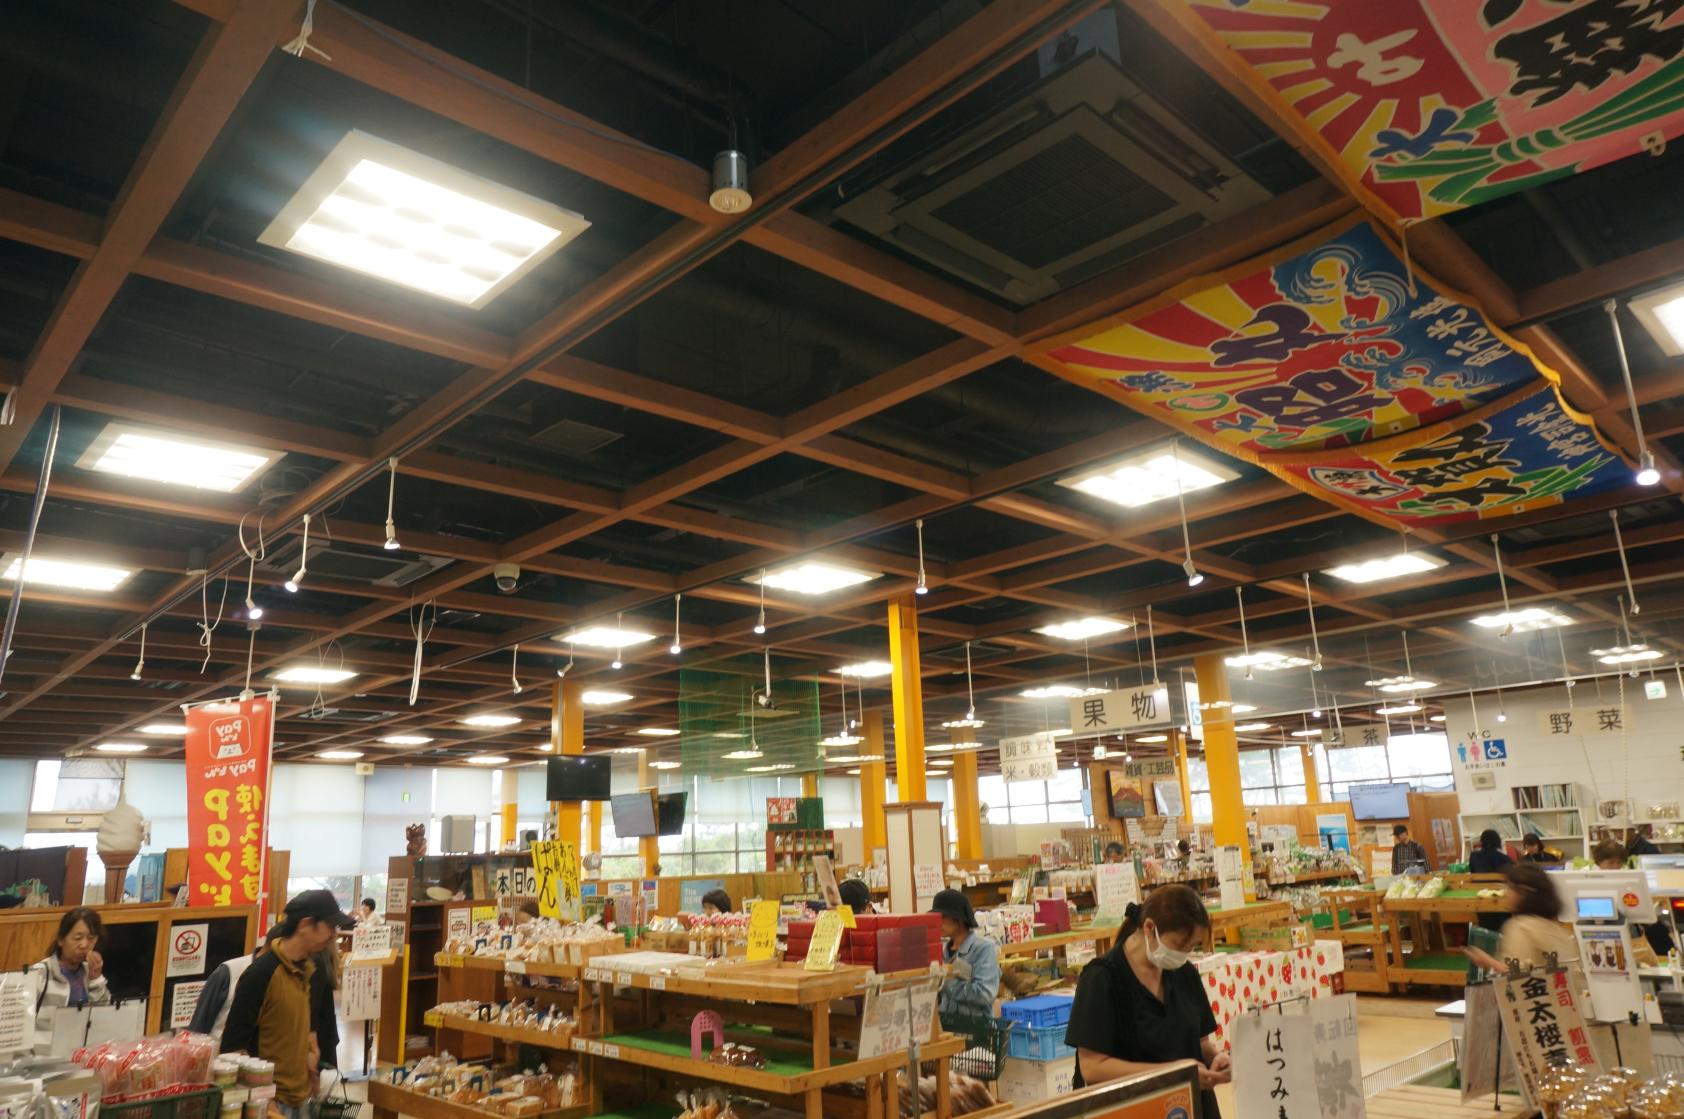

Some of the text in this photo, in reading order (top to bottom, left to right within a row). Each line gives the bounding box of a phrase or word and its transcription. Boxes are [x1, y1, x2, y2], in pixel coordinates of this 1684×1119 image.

[1083, 691, 1157, 727] 果物
[1550, 708, 1623, 735] 野菜
[498, 872, 536, 896] 本日の
